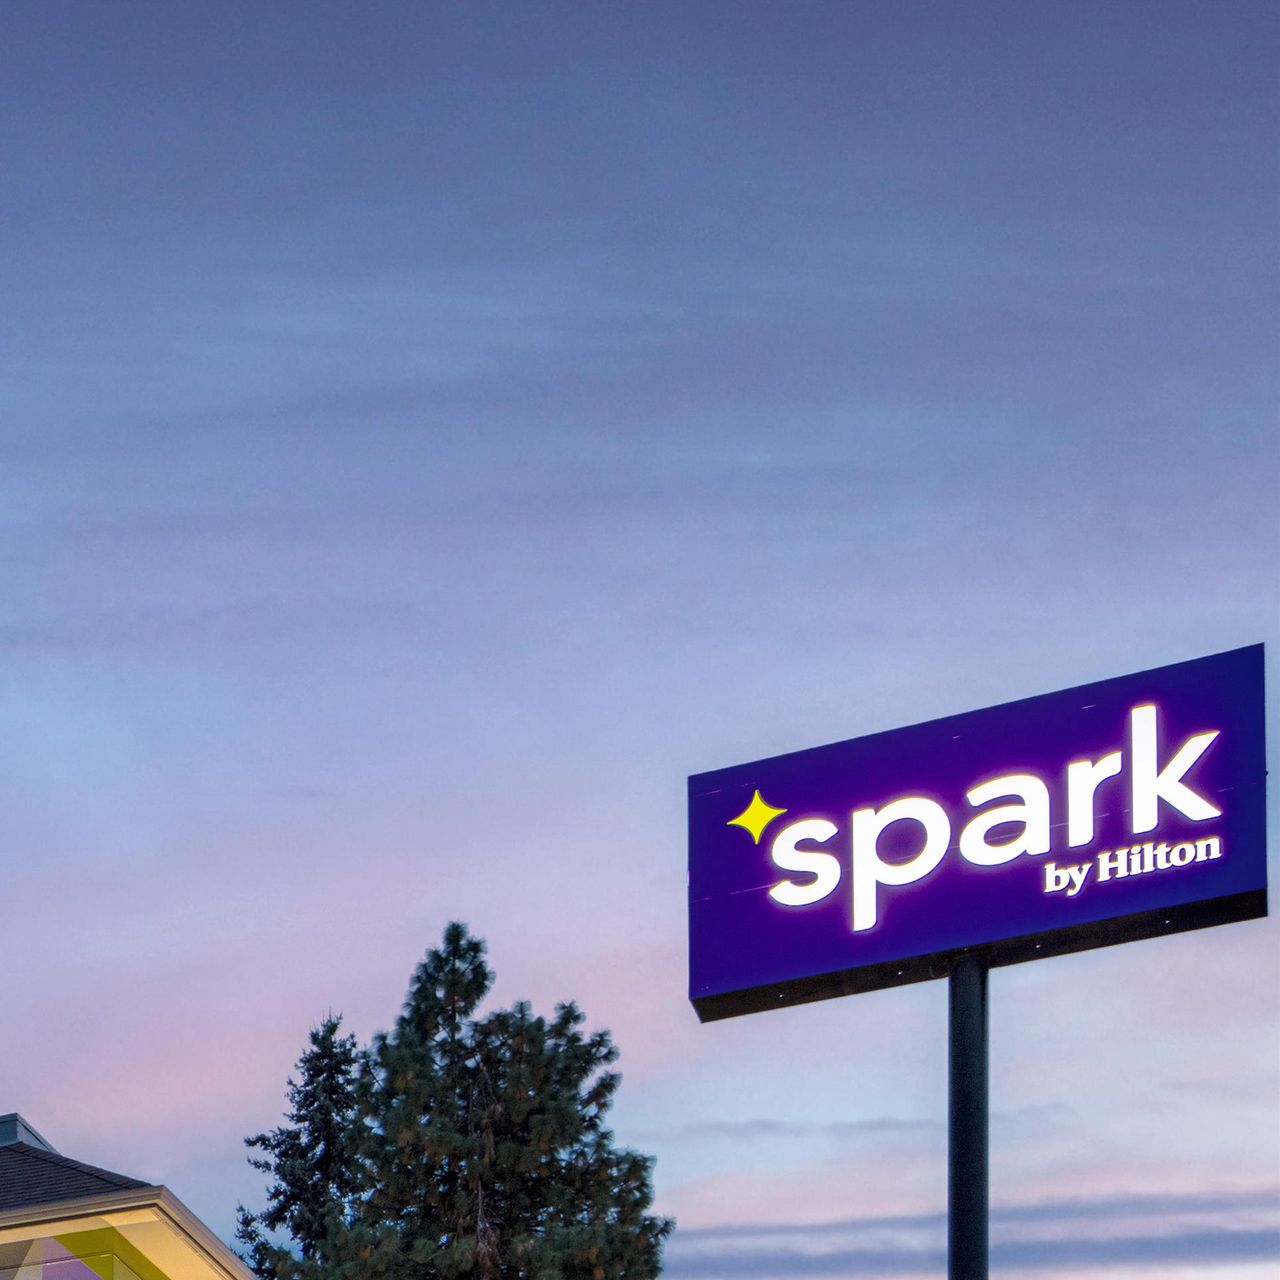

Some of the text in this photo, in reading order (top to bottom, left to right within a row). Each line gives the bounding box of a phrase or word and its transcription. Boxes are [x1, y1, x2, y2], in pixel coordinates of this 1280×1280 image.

[769, 704, 1222, 932] spark
[1043, 836, 1222, 897] by Hilton
